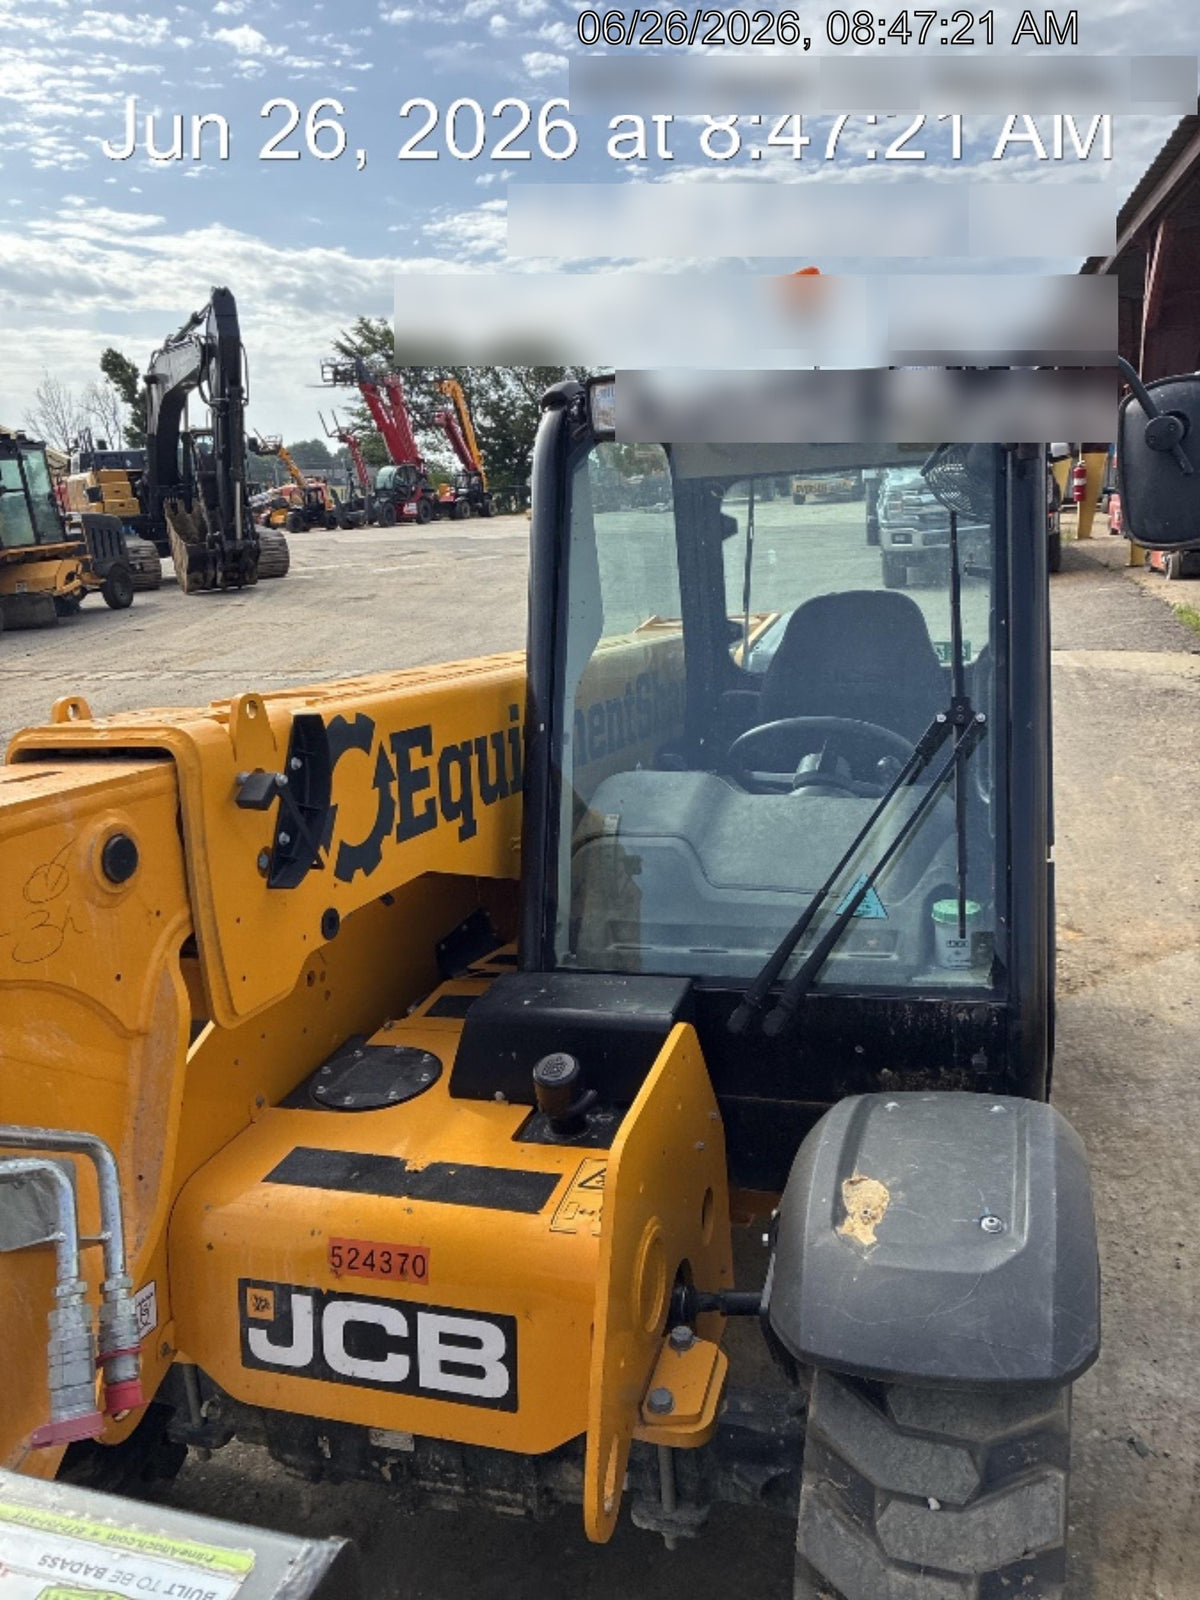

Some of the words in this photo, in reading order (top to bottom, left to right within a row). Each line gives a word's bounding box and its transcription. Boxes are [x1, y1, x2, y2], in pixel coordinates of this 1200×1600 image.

[331, 1246, 427, 1279] 524370
[248, 1293, 511, 1399] JCB
[37, 1554, 109, 1579] BADASS
[108, 1569, 137, 1587] BE
[136, 1576, 162, 1592] TO
[163, 1582, 217, 1600] BUILT
